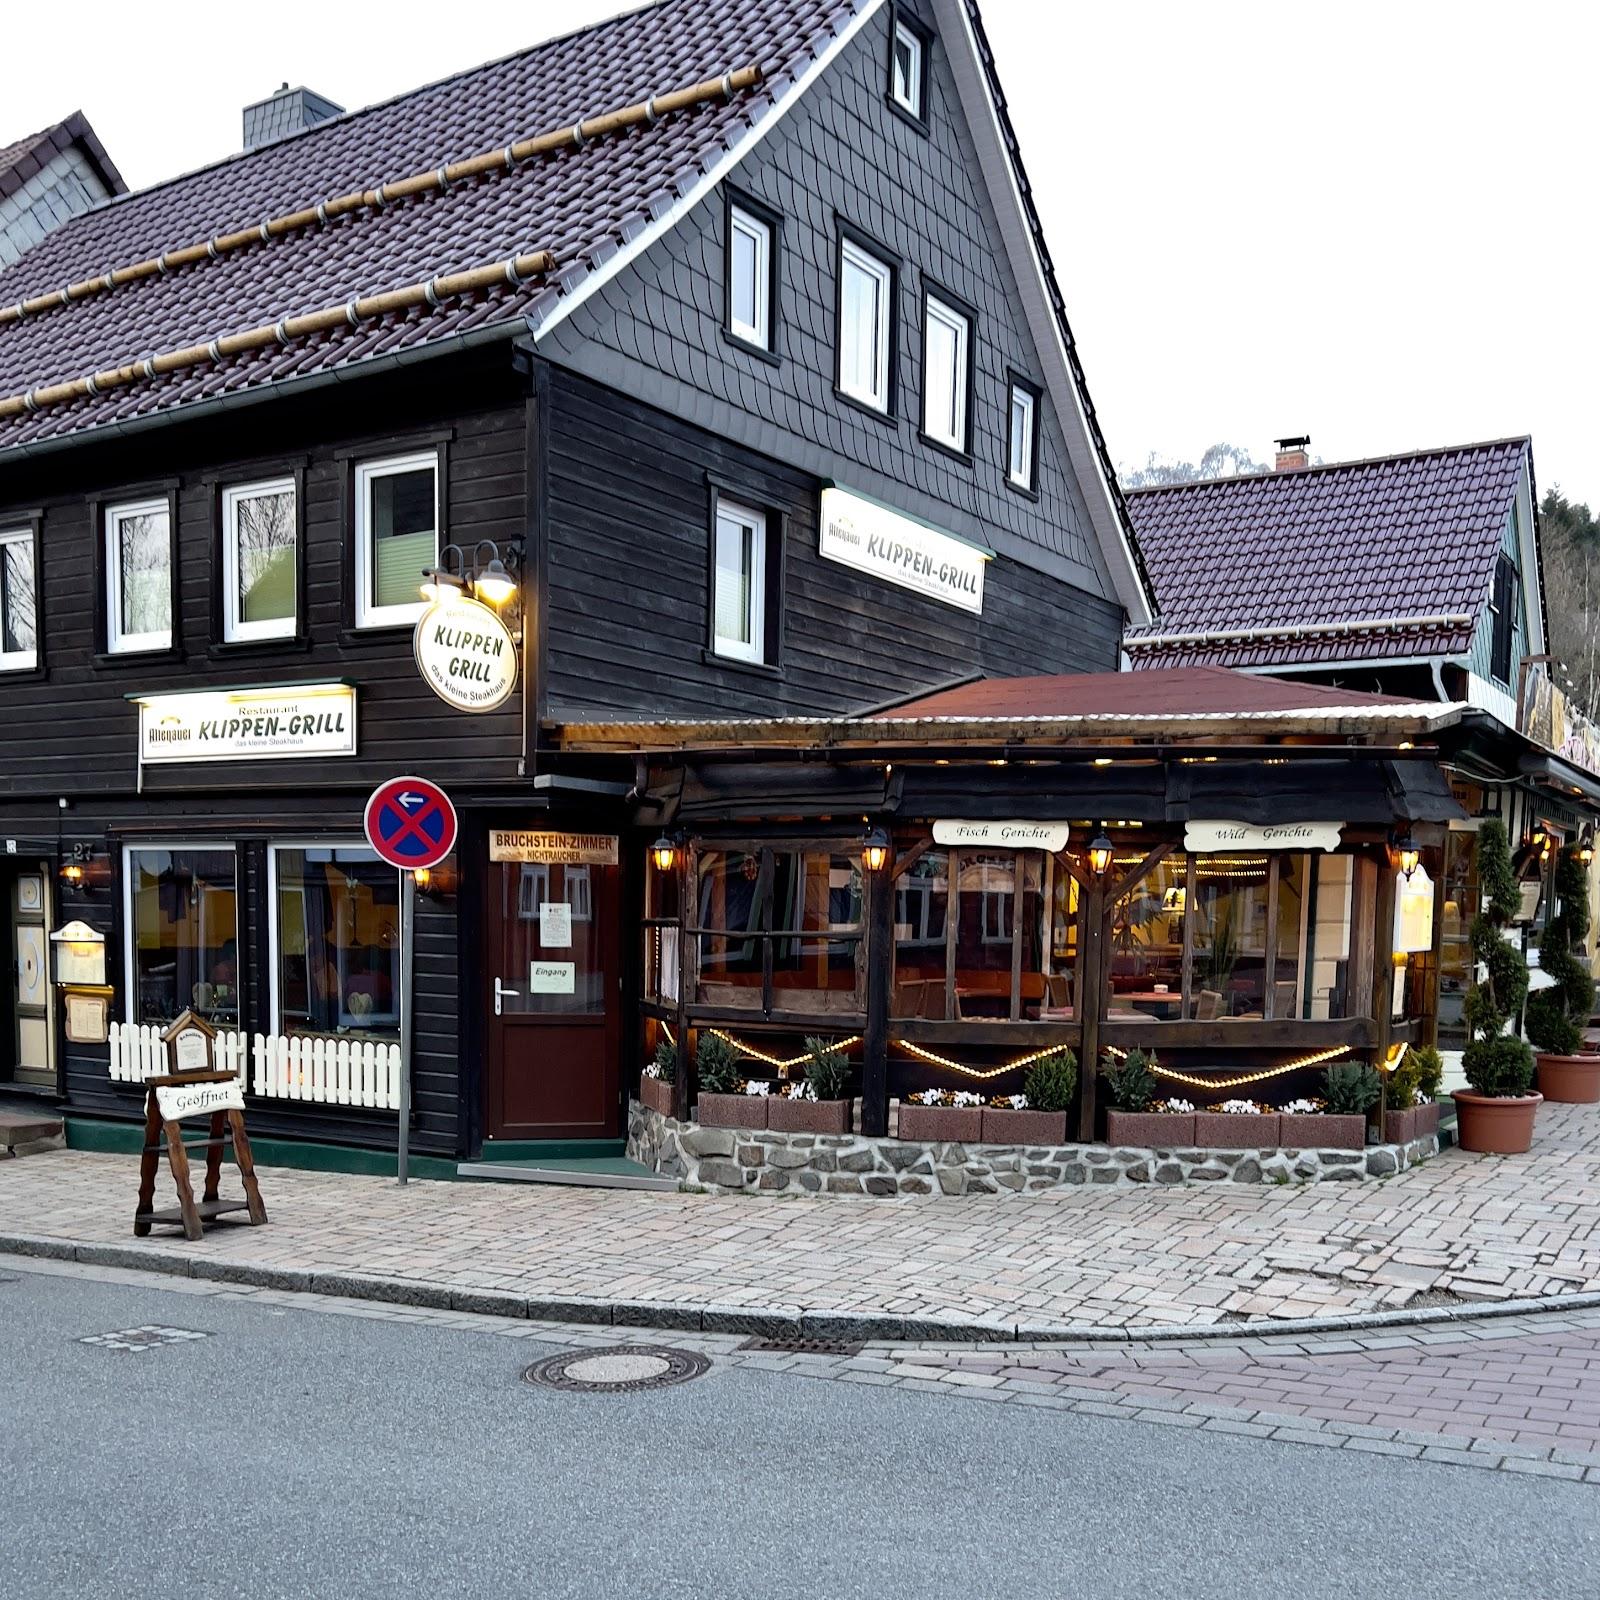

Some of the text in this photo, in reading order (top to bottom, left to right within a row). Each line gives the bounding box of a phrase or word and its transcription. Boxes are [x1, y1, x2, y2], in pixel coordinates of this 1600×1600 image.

[867, 533, 977, 595] KLIPPEN-GRILL
[434, 624, 504, 657] KLIPPEN
[448, 657, 491, 683] GRILL
[431, 664, 507, 702] das kleine Steakhaus
[238, 703, 299, 716] Restaurant
[198, 712, 345, 741] KLIPPEN-GRILL
[234, 737, 304, 748] das kleine Steakhaus
[956, 824, 1051, 840] Fisch Gerichte
[1215, 826, 1313, 841] Wild Gerichte
[496, 833, 612, 850] BRUCHSTEIN-ZIMMER
[73, 842, 93, 861] 27
[527, 850, 581, 861] NICHTRAUCHER
[535, 967, 567, 977] Eingang
[176, 1089, 229, 1111] Geöffnet
